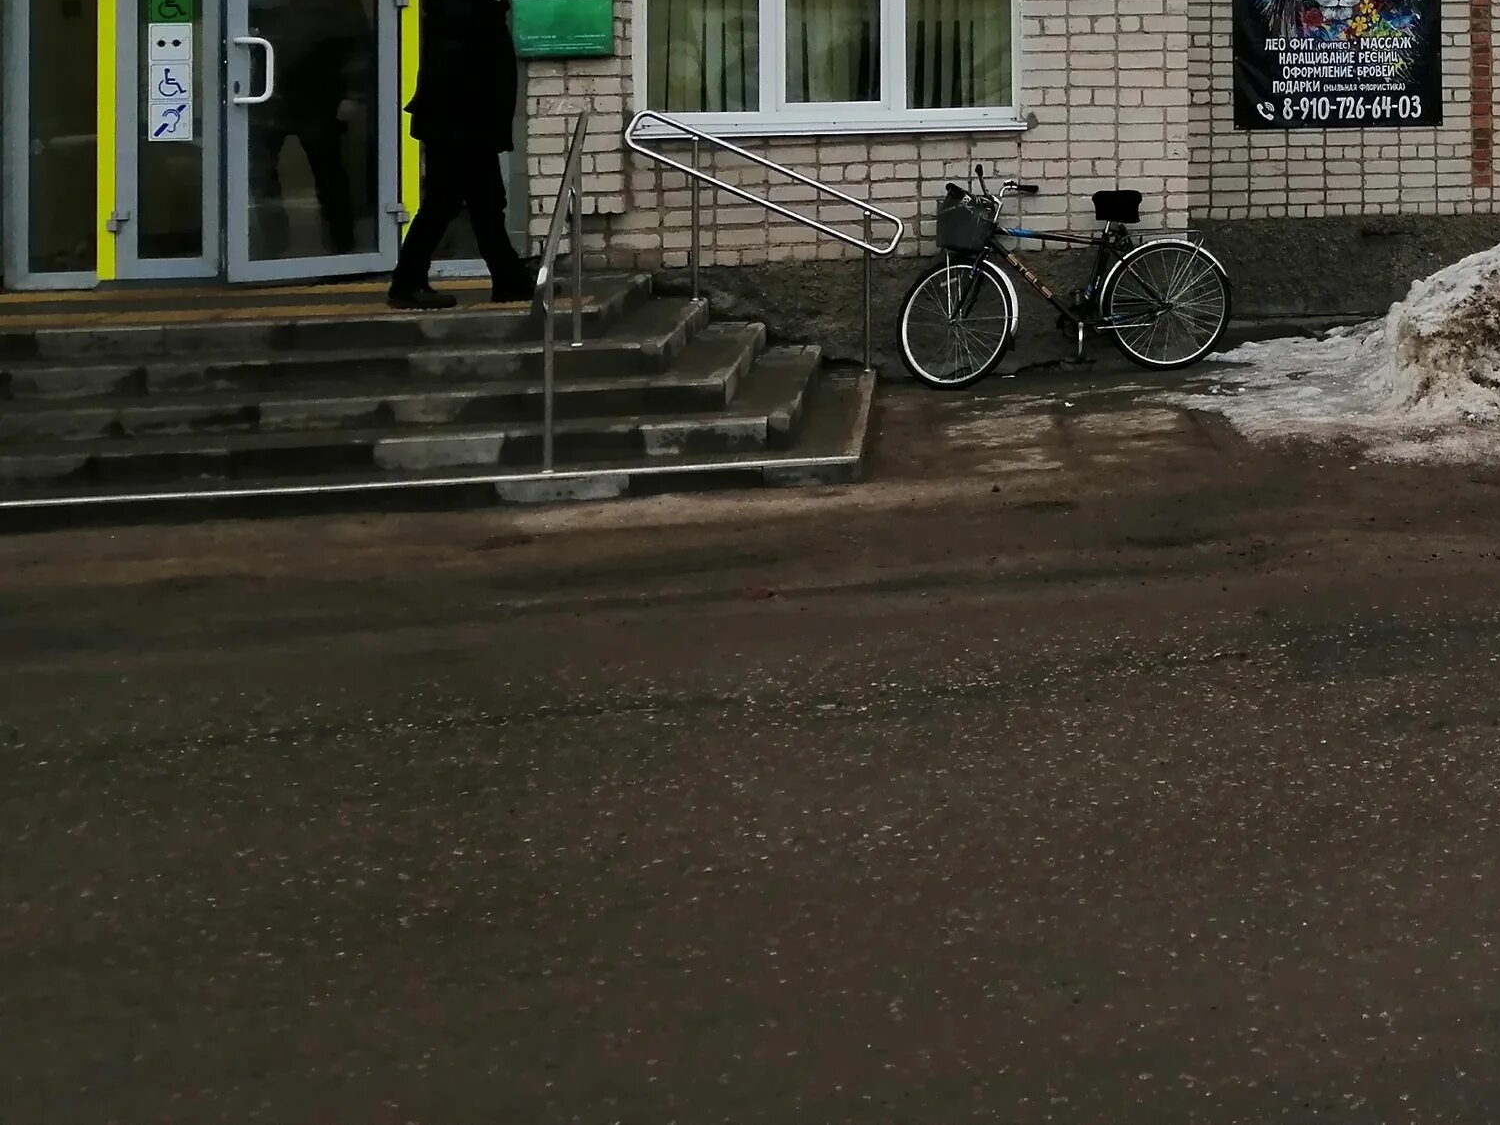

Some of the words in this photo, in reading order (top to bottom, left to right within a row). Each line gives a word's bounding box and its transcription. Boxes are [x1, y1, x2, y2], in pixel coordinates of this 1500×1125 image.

[1265, 38, 1286, 51] ЛЕО
[1289, 38, 1314, 51] ФИТ
[1360, 37, 1412, 50] МАССАЖ
[1279, 51, 1355, 65] НАРАЩИВАНИЕ
[1358, 51, 1399, 65] РЕСНИЦ
[1282, 65, 1354, 79] ОФОРМЛЕНИЕ
[1272, 80, 1320, 94] ПОДАРКИ
[1282, 95, 1422, 120] 8-910-726-64-03
